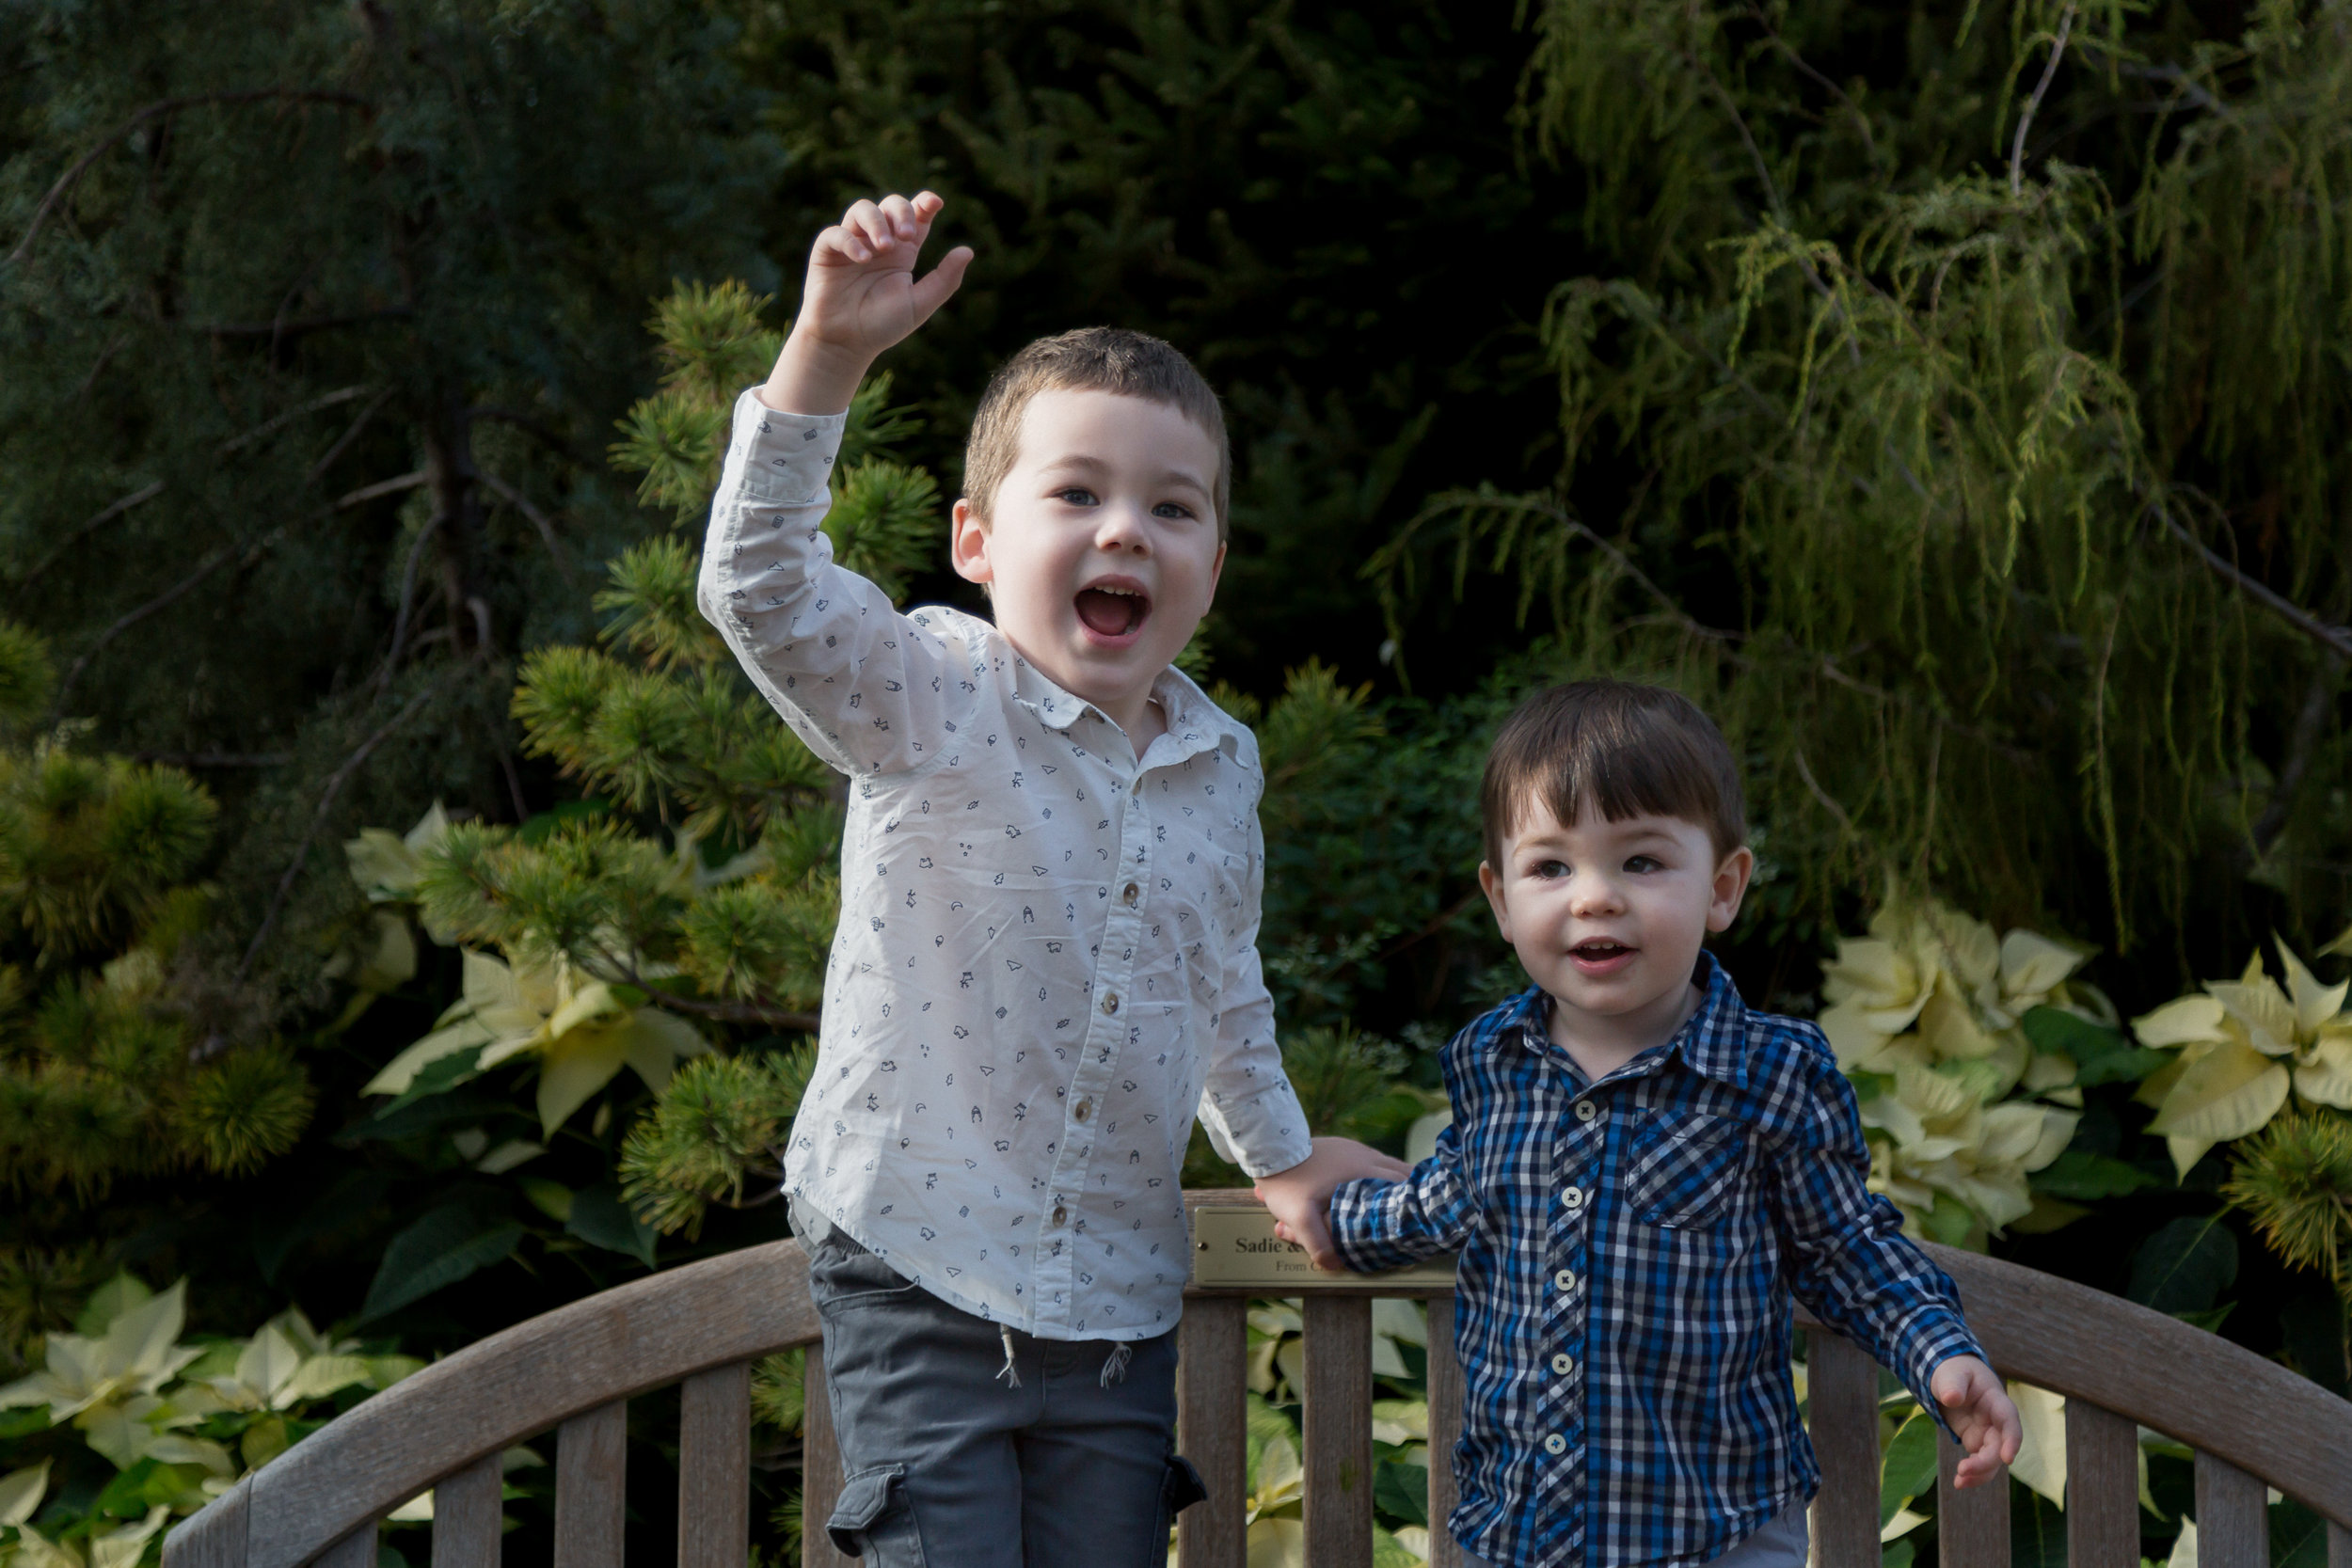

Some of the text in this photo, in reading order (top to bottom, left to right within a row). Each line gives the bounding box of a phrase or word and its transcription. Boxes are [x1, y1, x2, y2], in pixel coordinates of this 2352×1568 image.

[1235, 1238, 1301, 1253] Sadie &
[1276, 1261, 1306, 1272] From
